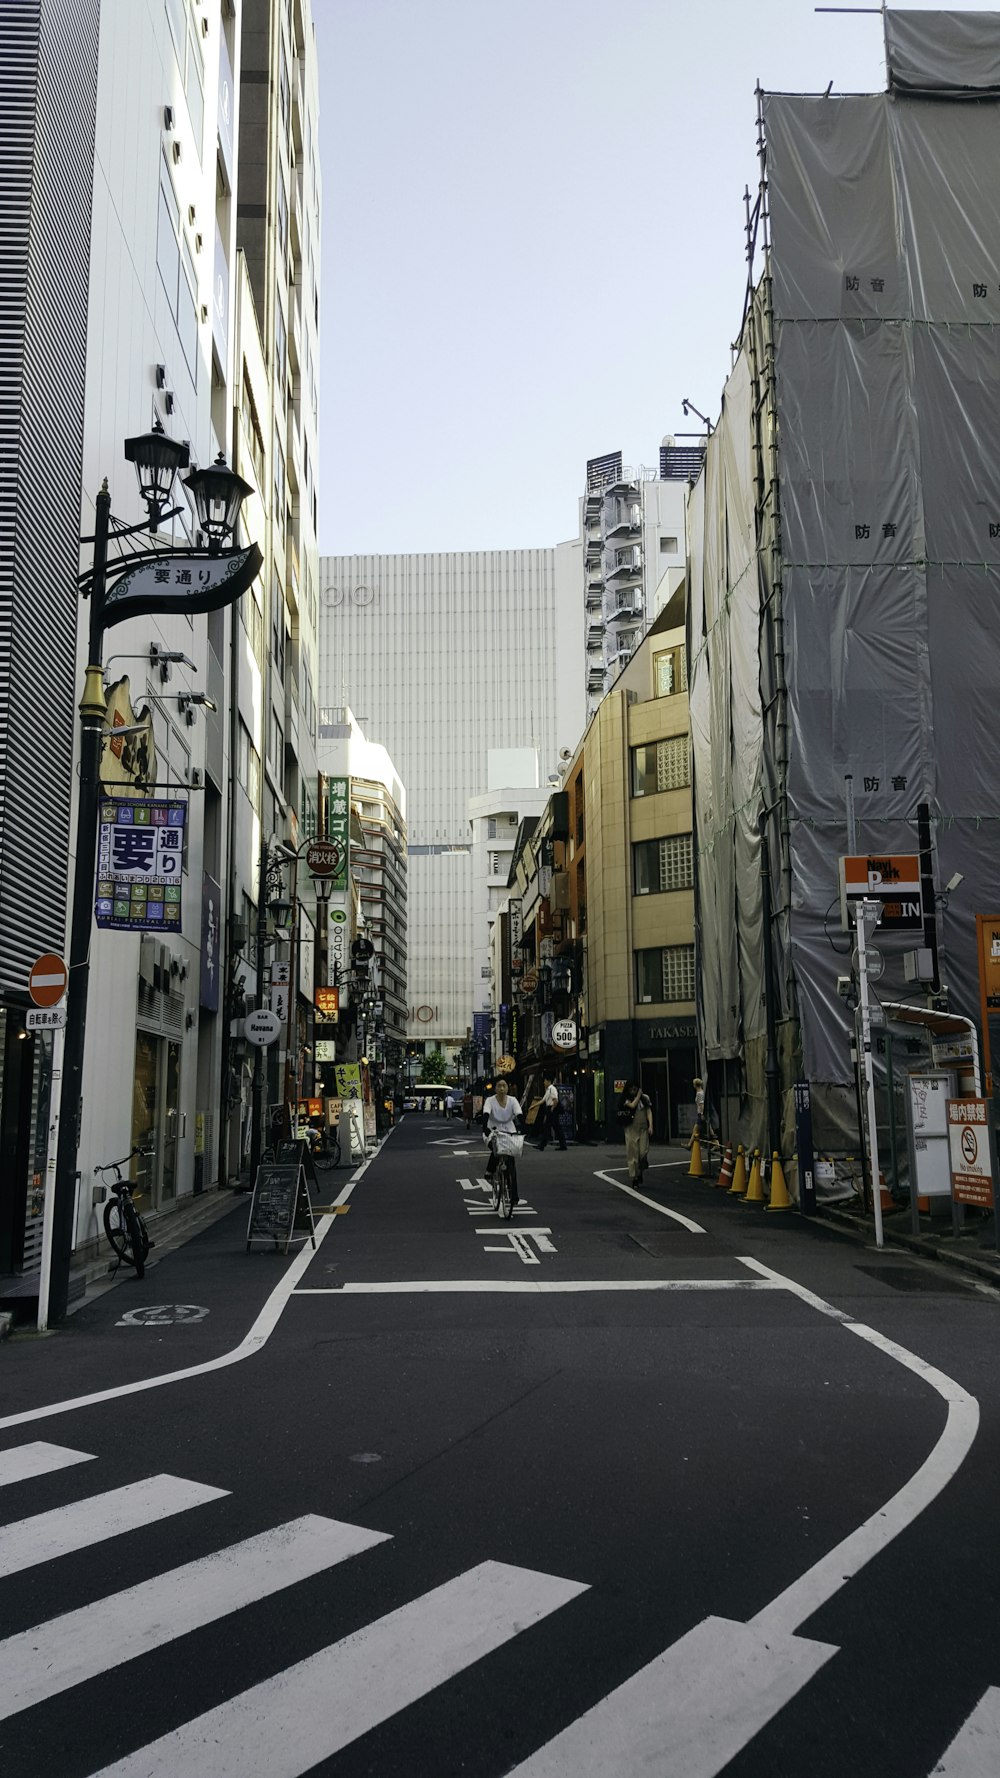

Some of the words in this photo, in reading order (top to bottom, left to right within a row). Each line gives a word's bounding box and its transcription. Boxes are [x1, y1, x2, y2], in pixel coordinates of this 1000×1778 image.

[845, 276, 885, 293] 防音
[855, 523, 897, 539] 防音
[154, 568, 211, 585] 要通り
[864, 776, 907, 792] 防音
[100, 825, 110, 872] 新宿三丁目
[309, 851, 337, 866] 消火栓
[867, 859, 892, 871] Navi
[99, 873, 181, 885] ふれあいまつり2016
[901, 902, 920, 917] IN
[29, 1012, 63, 1025] 自転車を除く
[250, 1023, 274, 1033] Havana
[556, 1032, 573, 1042] 500
[950, 1104, 986, 1122] 場内禁煙
